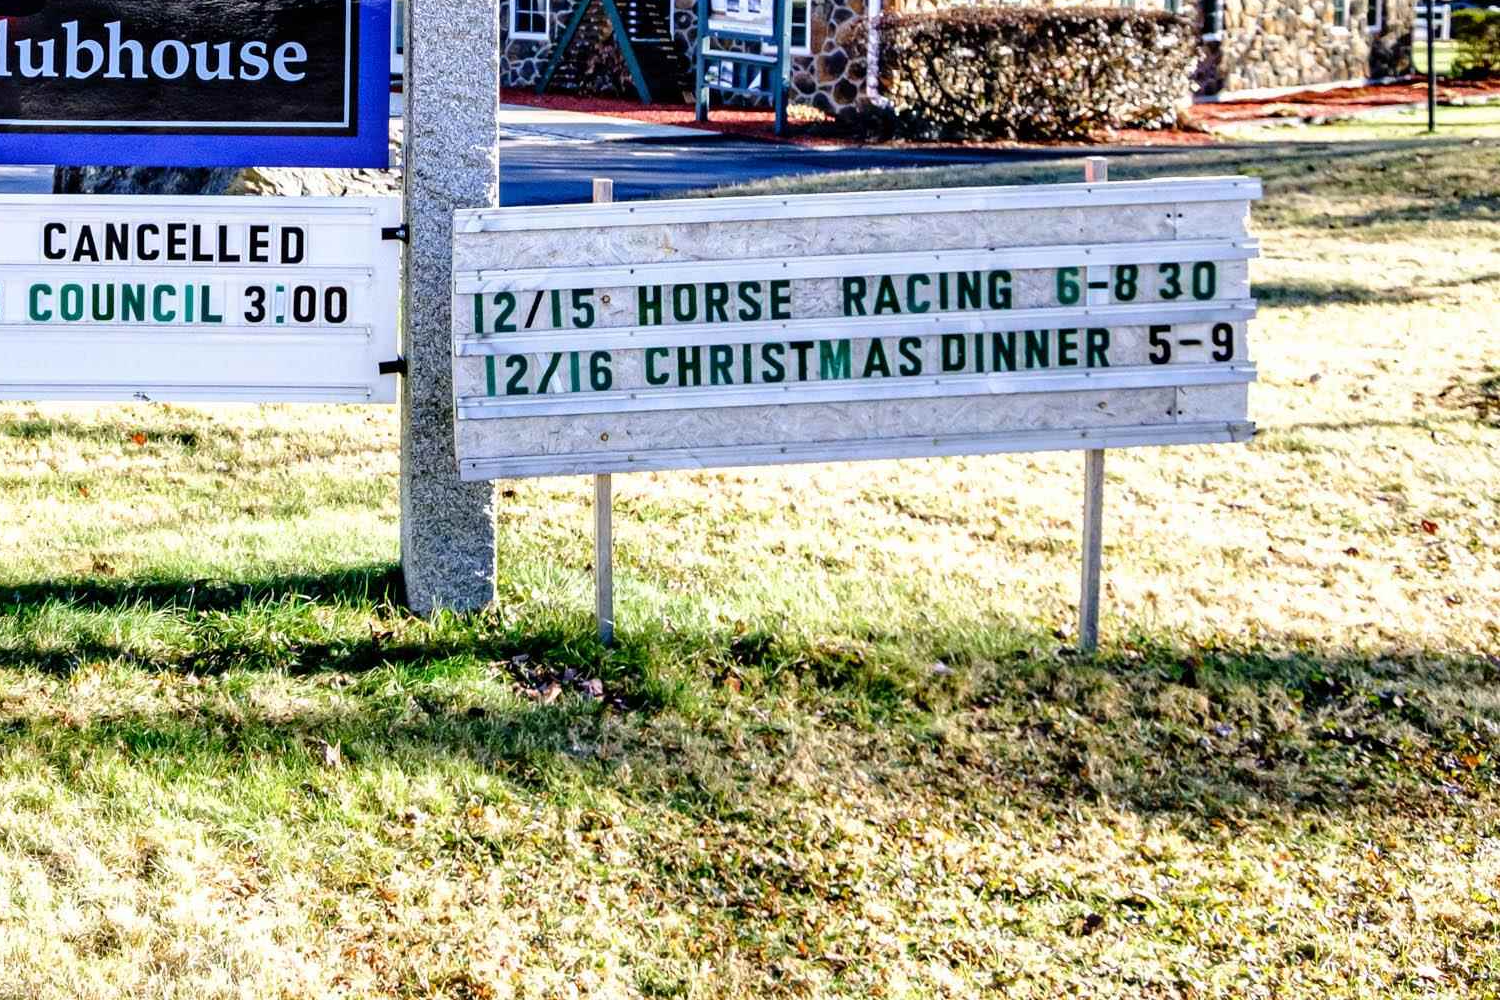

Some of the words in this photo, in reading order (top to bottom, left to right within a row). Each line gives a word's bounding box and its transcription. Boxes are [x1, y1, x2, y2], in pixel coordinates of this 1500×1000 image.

[43, 222, 305, 264] CANCELLED
[28, 283, 223, 323] COUNCIL
[244, 285, 348, 324] 3:00
[474, 288, 596, 334] 12/15
[638, 279, 791, 326] HORSE
[843, 269, 1012, 316] RACING
[485, 351, 613, 397] 12/16
[645, 336, 921, 386] CHRISTMAS
[942, 327, 1110, 373] DINNER
[1148, 322, 1233, 364] 5-9
